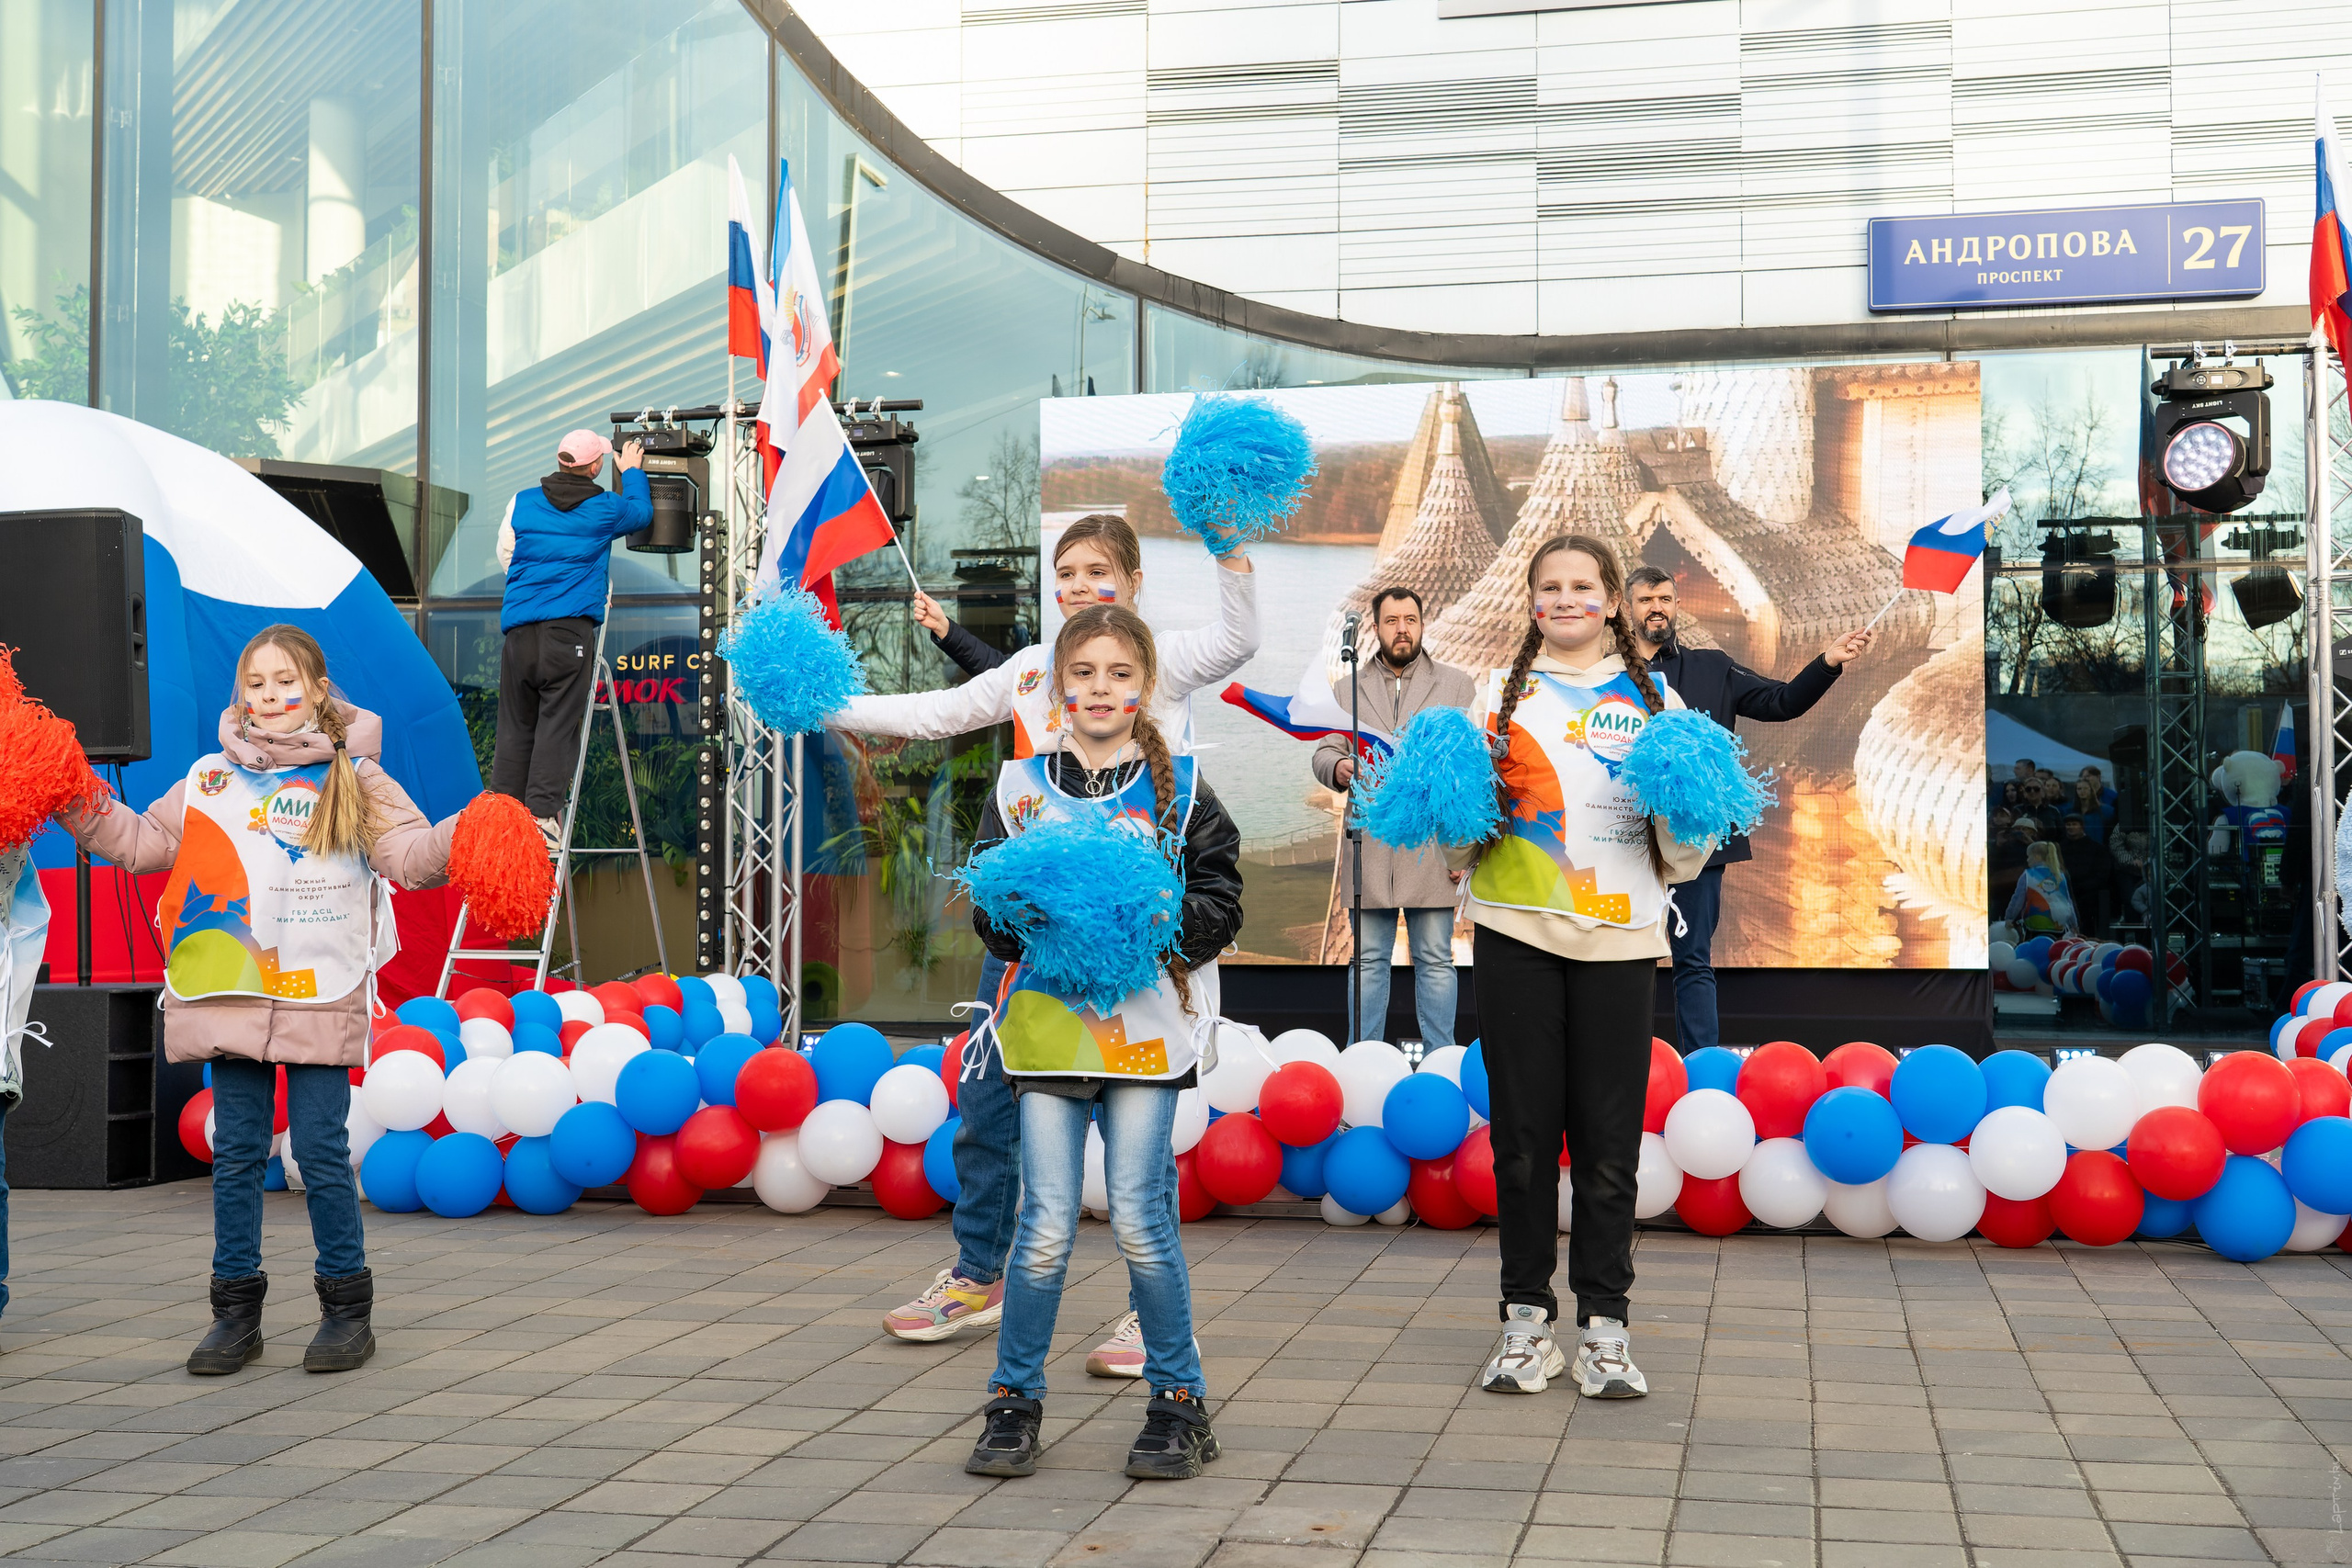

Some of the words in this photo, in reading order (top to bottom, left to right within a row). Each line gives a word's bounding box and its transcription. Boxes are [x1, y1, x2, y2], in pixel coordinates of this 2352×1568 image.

[1904, 229, 2138, 266] АНДРОПОВА
[2182, 225, 2253, 270] 27
[1977, 269, 2064, 285] ПРОСПЕКТ
[616, 654, 675, 671] SURF
[686, 653, 700, 670] C
[1591, 711, 1643, 735] МИР
[1590, 730, 1635, 744] МОЛОДЫ
[272, 816, 309, 829] МОЛОД
[294, 876, 326, 886] Южный
[311, 908, 333, 916] ДСЦ
